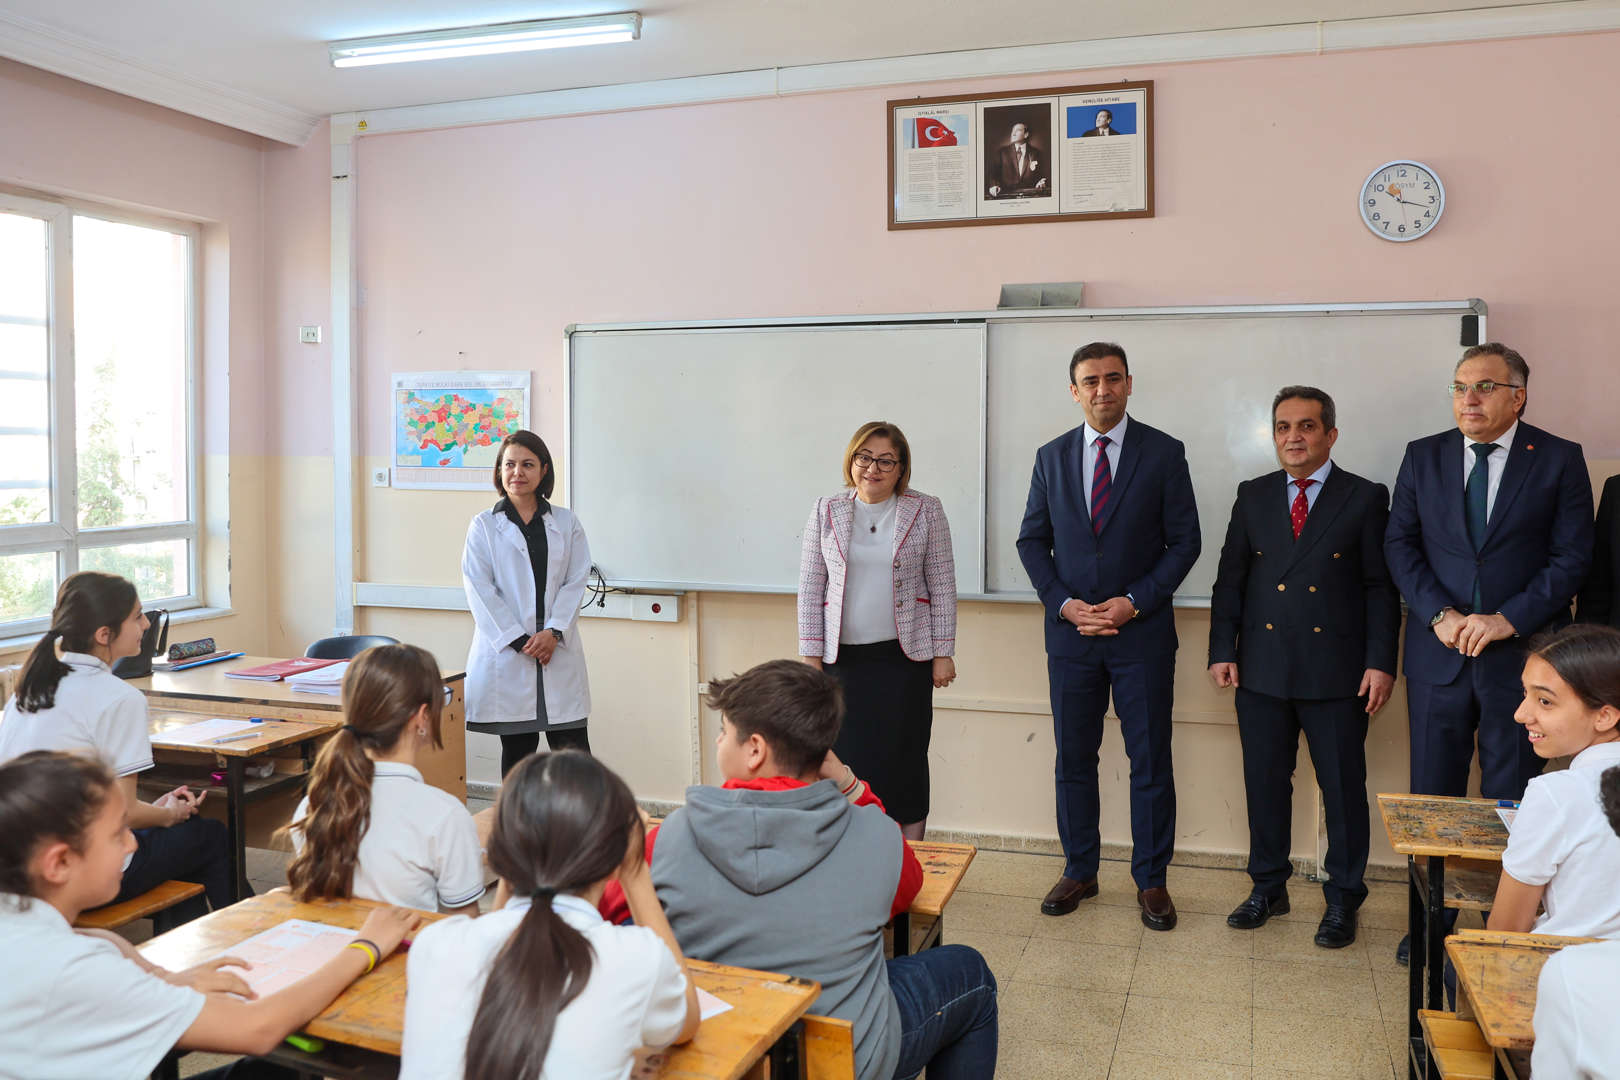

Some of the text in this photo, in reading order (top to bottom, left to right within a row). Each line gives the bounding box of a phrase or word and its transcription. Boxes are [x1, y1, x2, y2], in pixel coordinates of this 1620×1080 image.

[1397, 169, 1407, 177] 12
[1384, 174, 1391, 182] 11
[1374, 184, 1385, 192] 10
[1423, 181, 1431, 190] 2
[1368, 199, 1376, 207] 9
[1428, 195, 1436, 204] 3
[1372, 212, 1381, 221] 8
[1423, 209, 1431, 218] 4
[1382, 221, 1390, 230] 7
[1398, 224, 1406, 233] 6
[1414, 220, 1422, 229] 5
